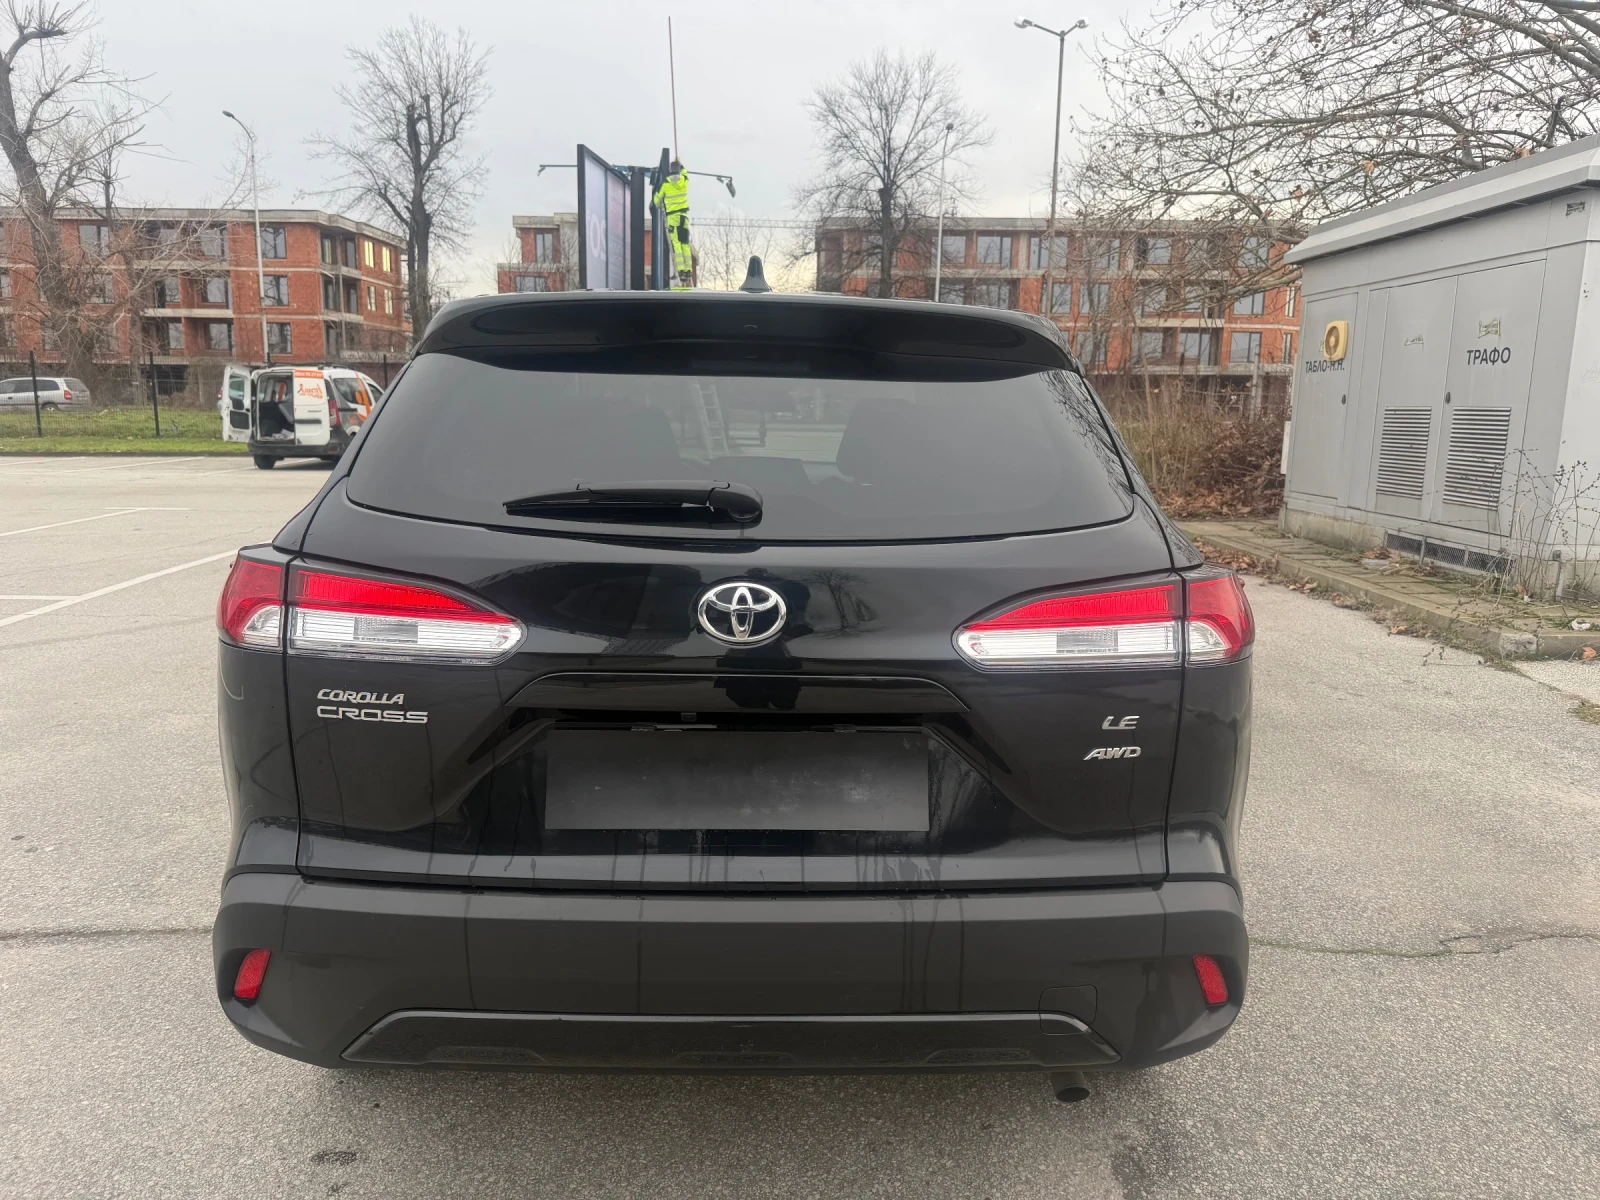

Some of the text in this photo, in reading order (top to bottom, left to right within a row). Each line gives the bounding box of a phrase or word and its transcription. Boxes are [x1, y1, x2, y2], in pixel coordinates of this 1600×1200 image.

[1466, 346, 1511, 366] ТРАФО
[316, 688, 405, 705] COROLLA
[316, 705, 429, 724] CROSS
[1101, 715, 1140, 730] LE
[1083, 746, 1142, 761] AWD
